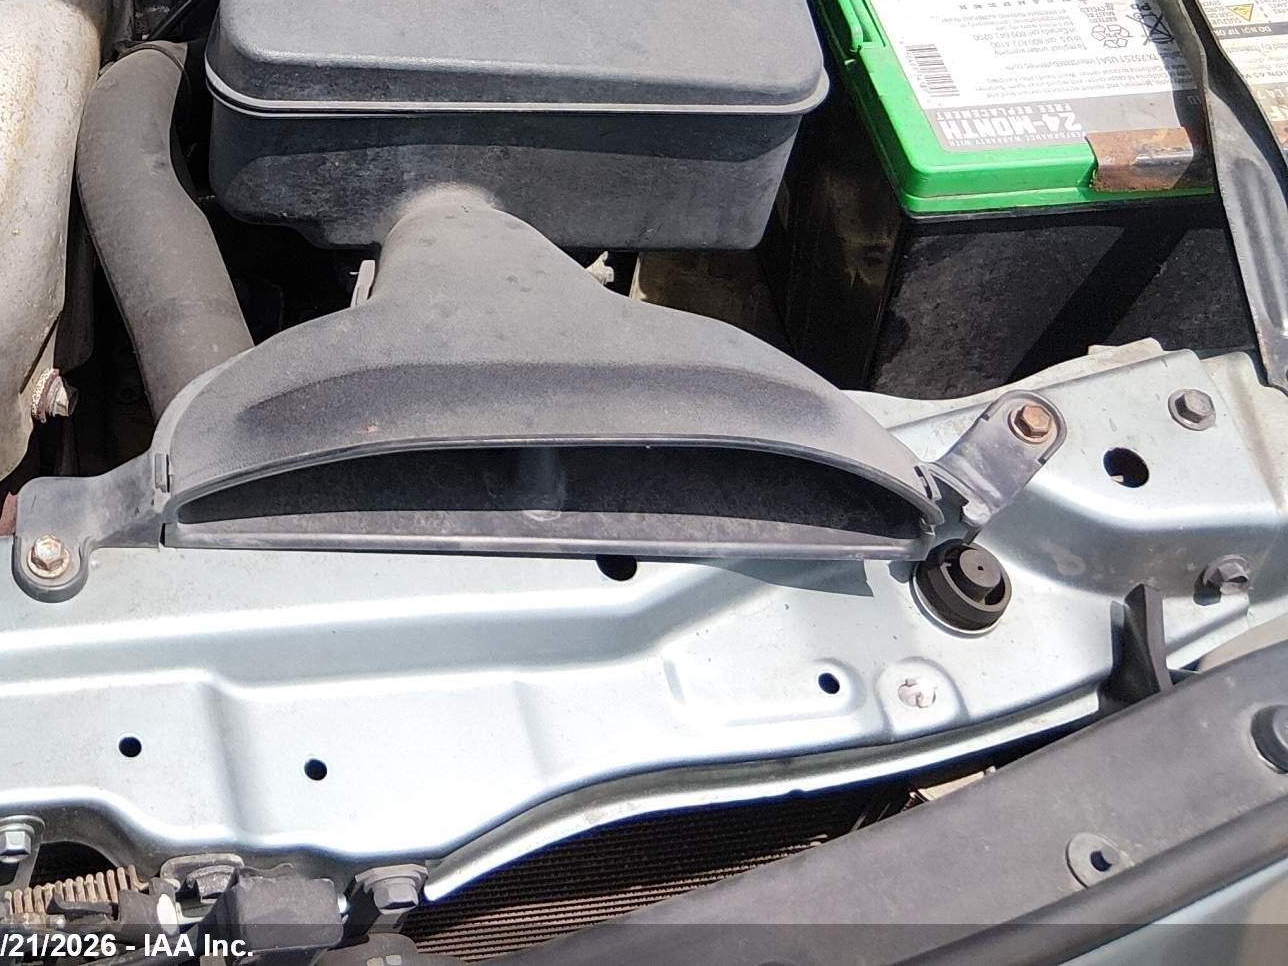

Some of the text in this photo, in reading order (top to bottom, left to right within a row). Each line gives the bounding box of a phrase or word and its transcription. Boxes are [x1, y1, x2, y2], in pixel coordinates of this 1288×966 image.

[936, 103, 1073, 121] FREE REPLACEMENT
[939, 112, 1082, 140] 24-MONTH
